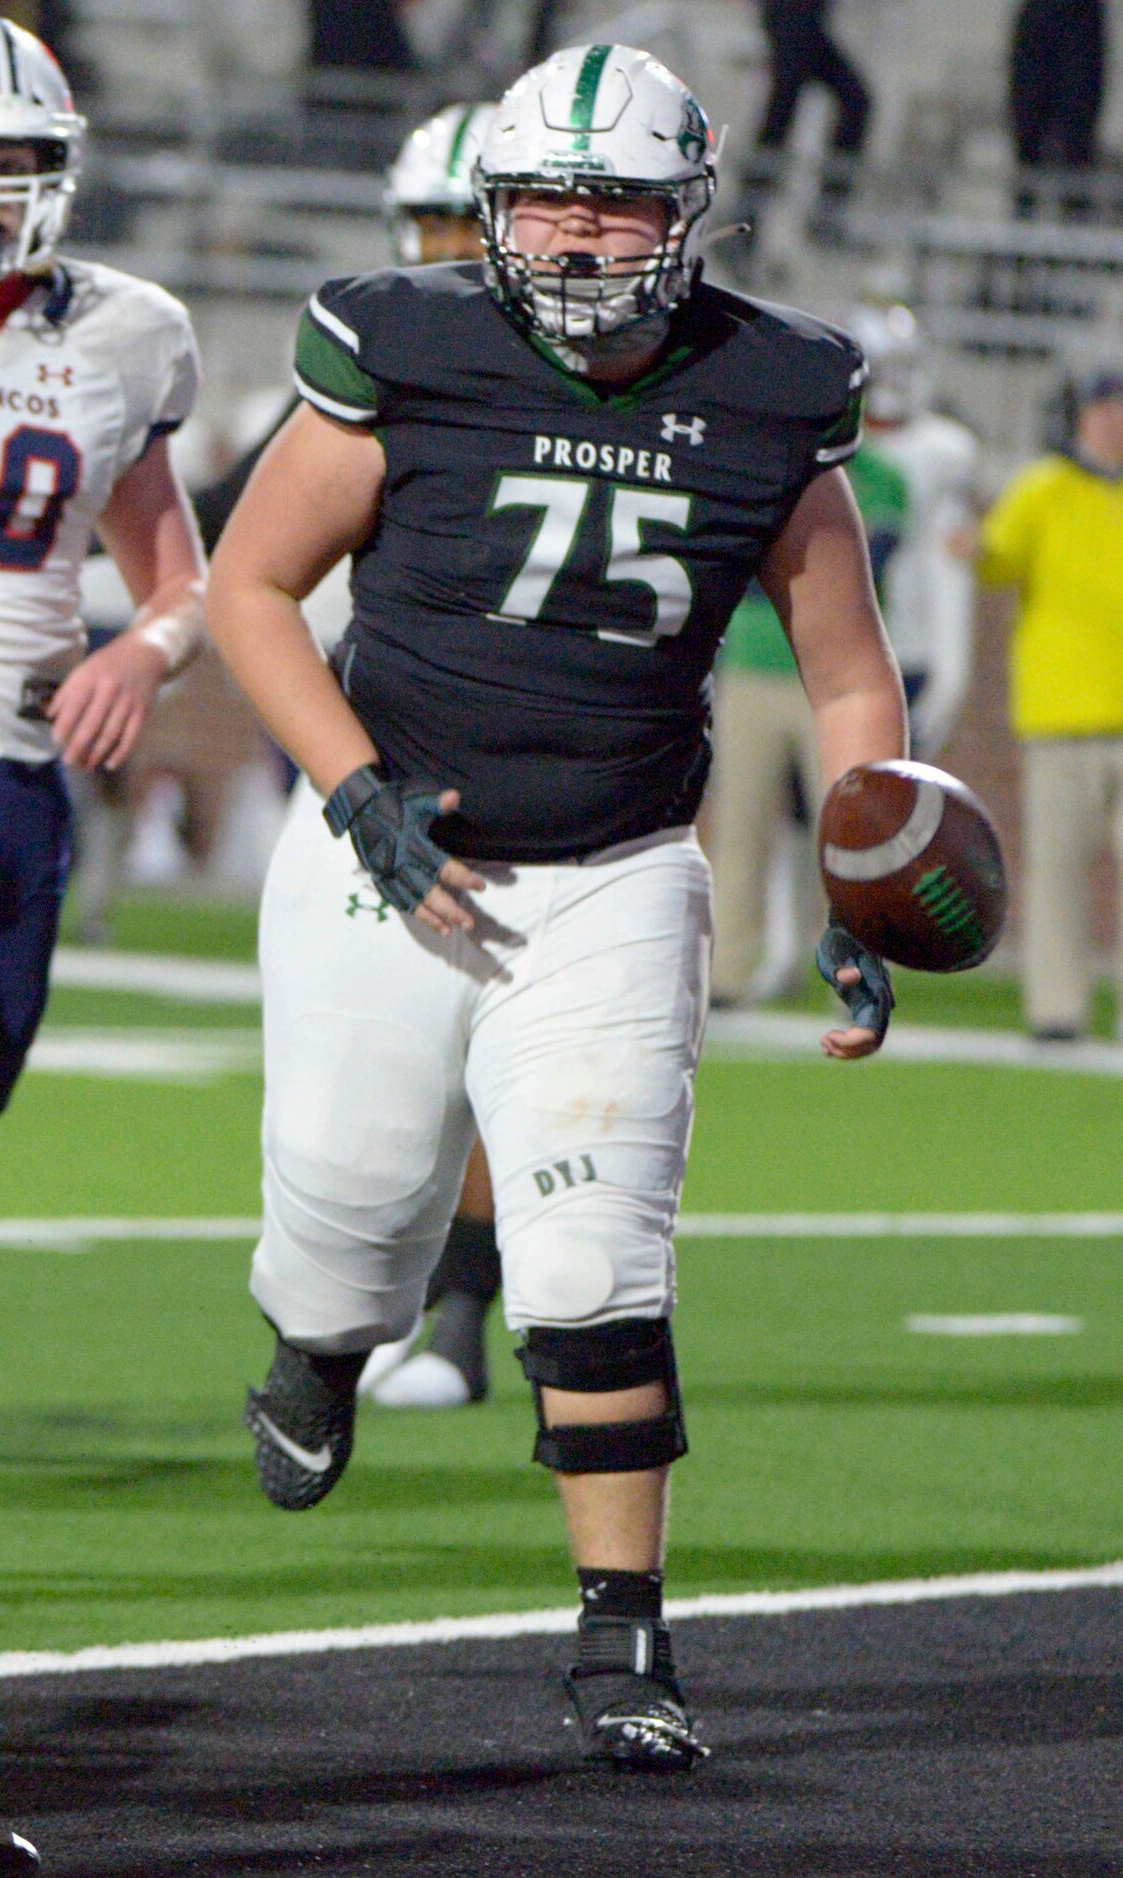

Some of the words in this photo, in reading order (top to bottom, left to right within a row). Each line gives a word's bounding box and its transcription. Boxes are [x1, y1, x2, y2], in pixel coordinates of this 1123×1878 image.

[534, 434, 672, 482] PROSPER
[487, 471, 693, 648] 75
[533, 1153, 596, 1198] DYJ
